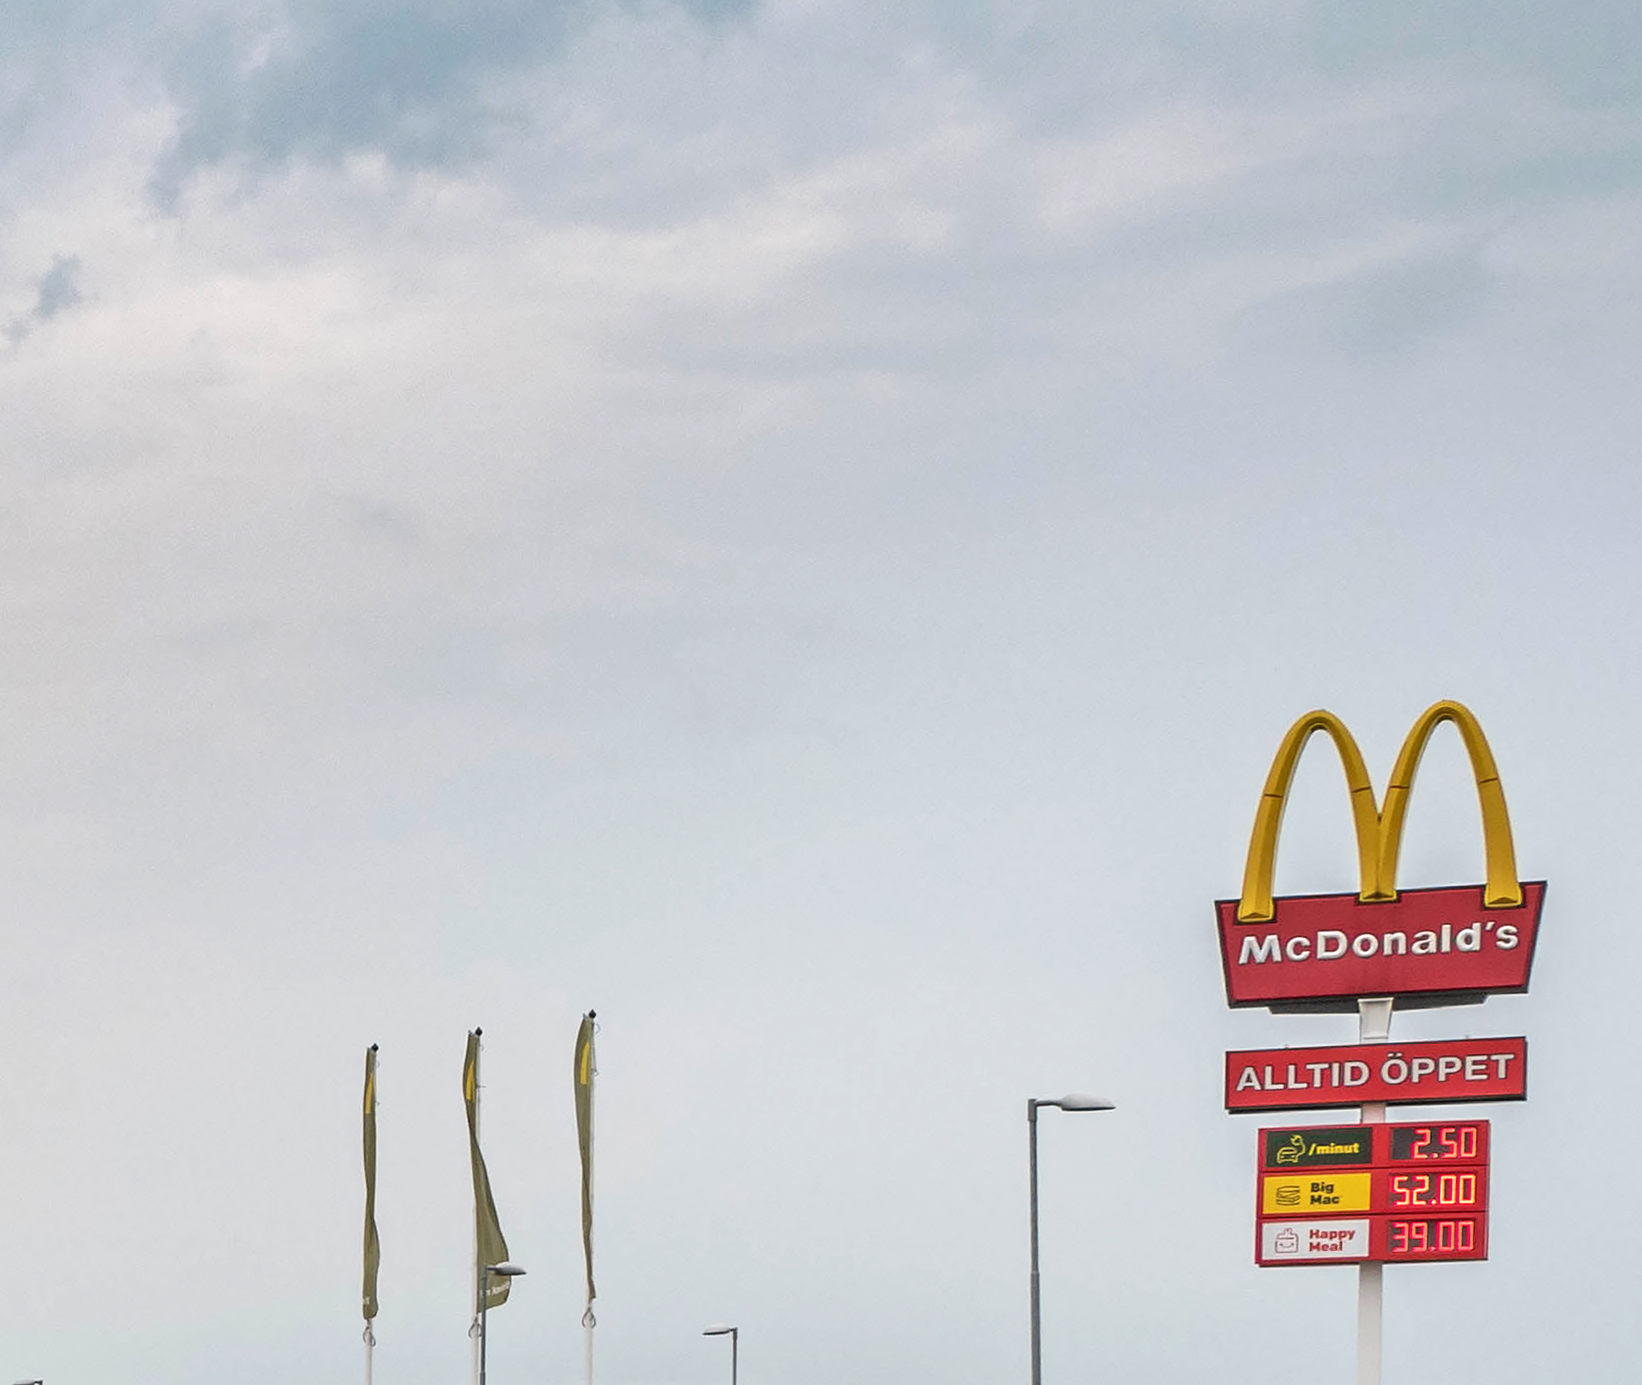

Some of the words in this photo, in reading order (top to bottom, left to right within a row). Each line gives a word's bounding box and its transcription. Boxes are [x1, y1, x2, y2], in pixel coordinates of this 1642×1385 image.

[1238, 921, 1519, 965] McDonald's
[1236, 1061, 1370, 1092] ALLTID
[1381, 1052, 1515, 1085] ÖPPET
[1308, 1142, 1360, 1156] /minut
[1411, 1127, 1477, 1159] 2.50
[1310, 1182, 1335, 1194] Big
[1391, 1174, 1476, 1206] 52.00
[1310, 1195, 1340, 1205] Mac
[1308, 1241, 1343, 1252] Meal
[1309, 1229, 1356, 1241] Happy
[1392, 1221, 1475, 1253] 39.00
